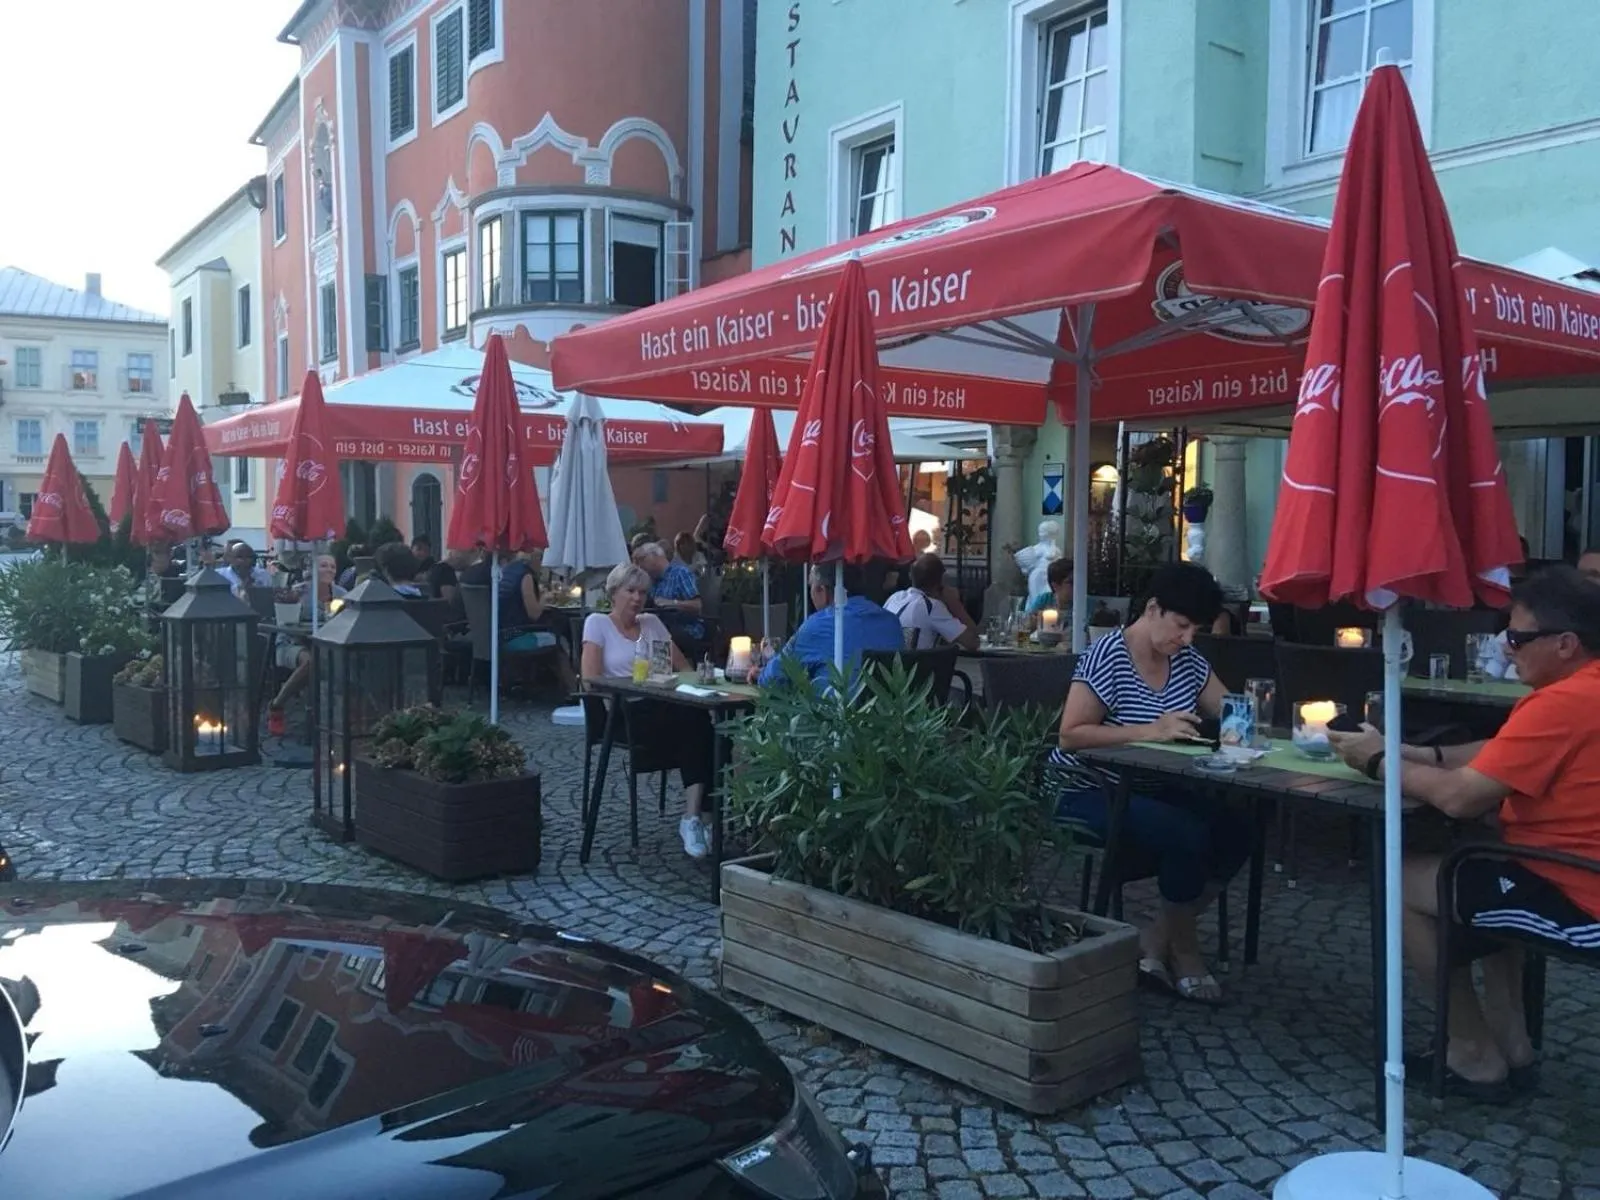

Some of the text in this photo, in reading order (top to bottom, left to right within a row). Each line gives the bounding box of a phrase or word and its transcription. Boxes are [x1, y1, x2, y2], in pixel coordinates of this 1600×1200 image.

[640, 326, 677, 361] Hast
[682, 319, 710, 352] ein
[716, 308, 774, 347] Kaiser
[891, 267, 972, 314] Kaiser
[1491, 283, 1527, 326] bist
[1531, 294, 1556, 331] ein
[1559, 301, 1600, 340] Kaise
[413, 417, 450, 436] Hast
[455, 418, 470, 437] ei
[547, 423, 569, 441] bis
[606, 426, 649, 444] Kaiser
